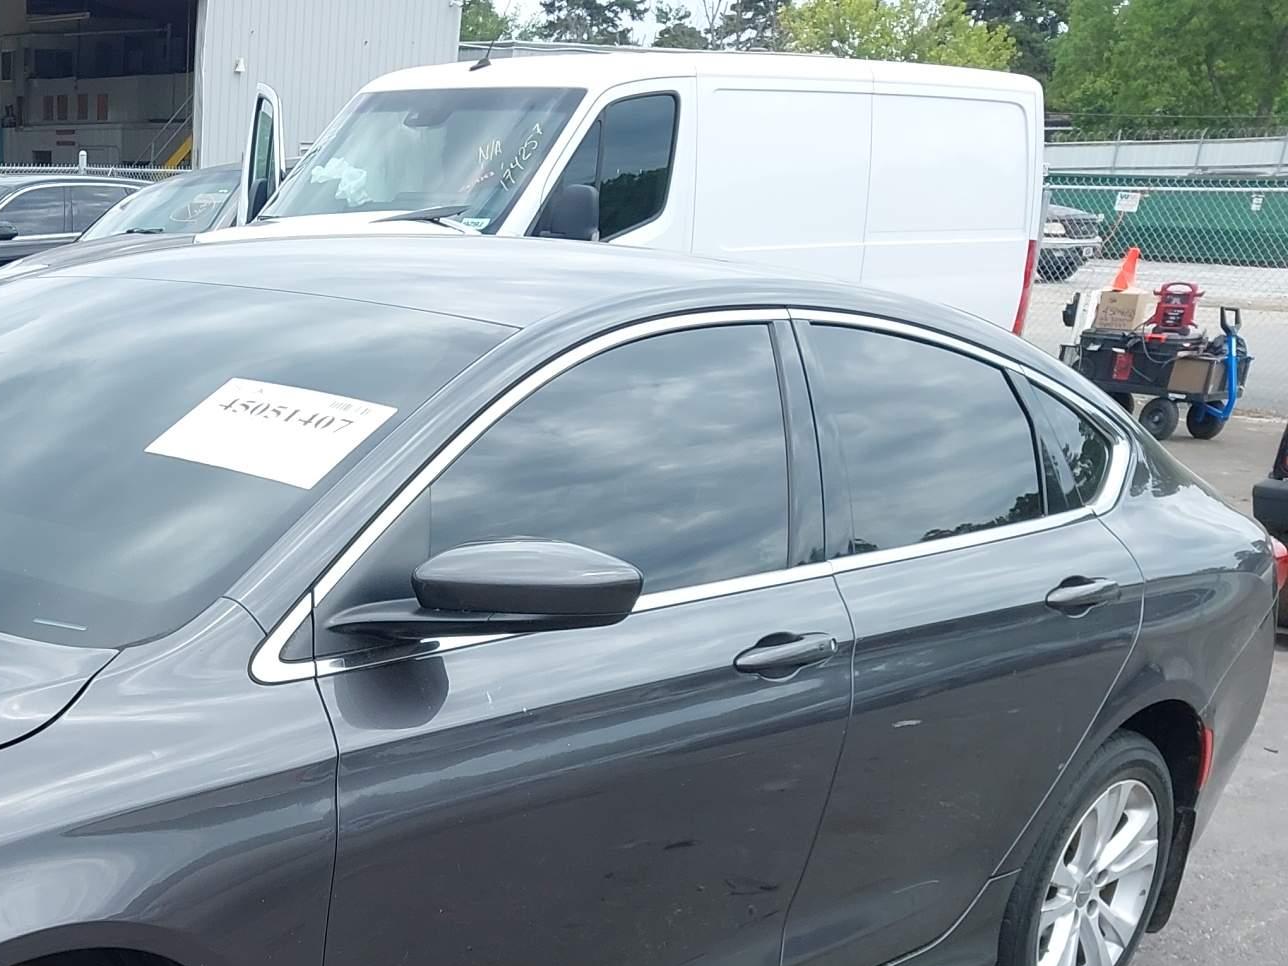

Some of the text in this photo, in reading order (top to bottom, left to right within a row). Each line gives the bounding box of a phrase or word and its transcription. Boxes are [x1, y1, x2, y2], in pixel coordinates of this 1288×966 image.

[478, 139, 502, 163] N/A
[500, 123, 542, 191] 174257
[219, 398, 354, 433] 45051407
